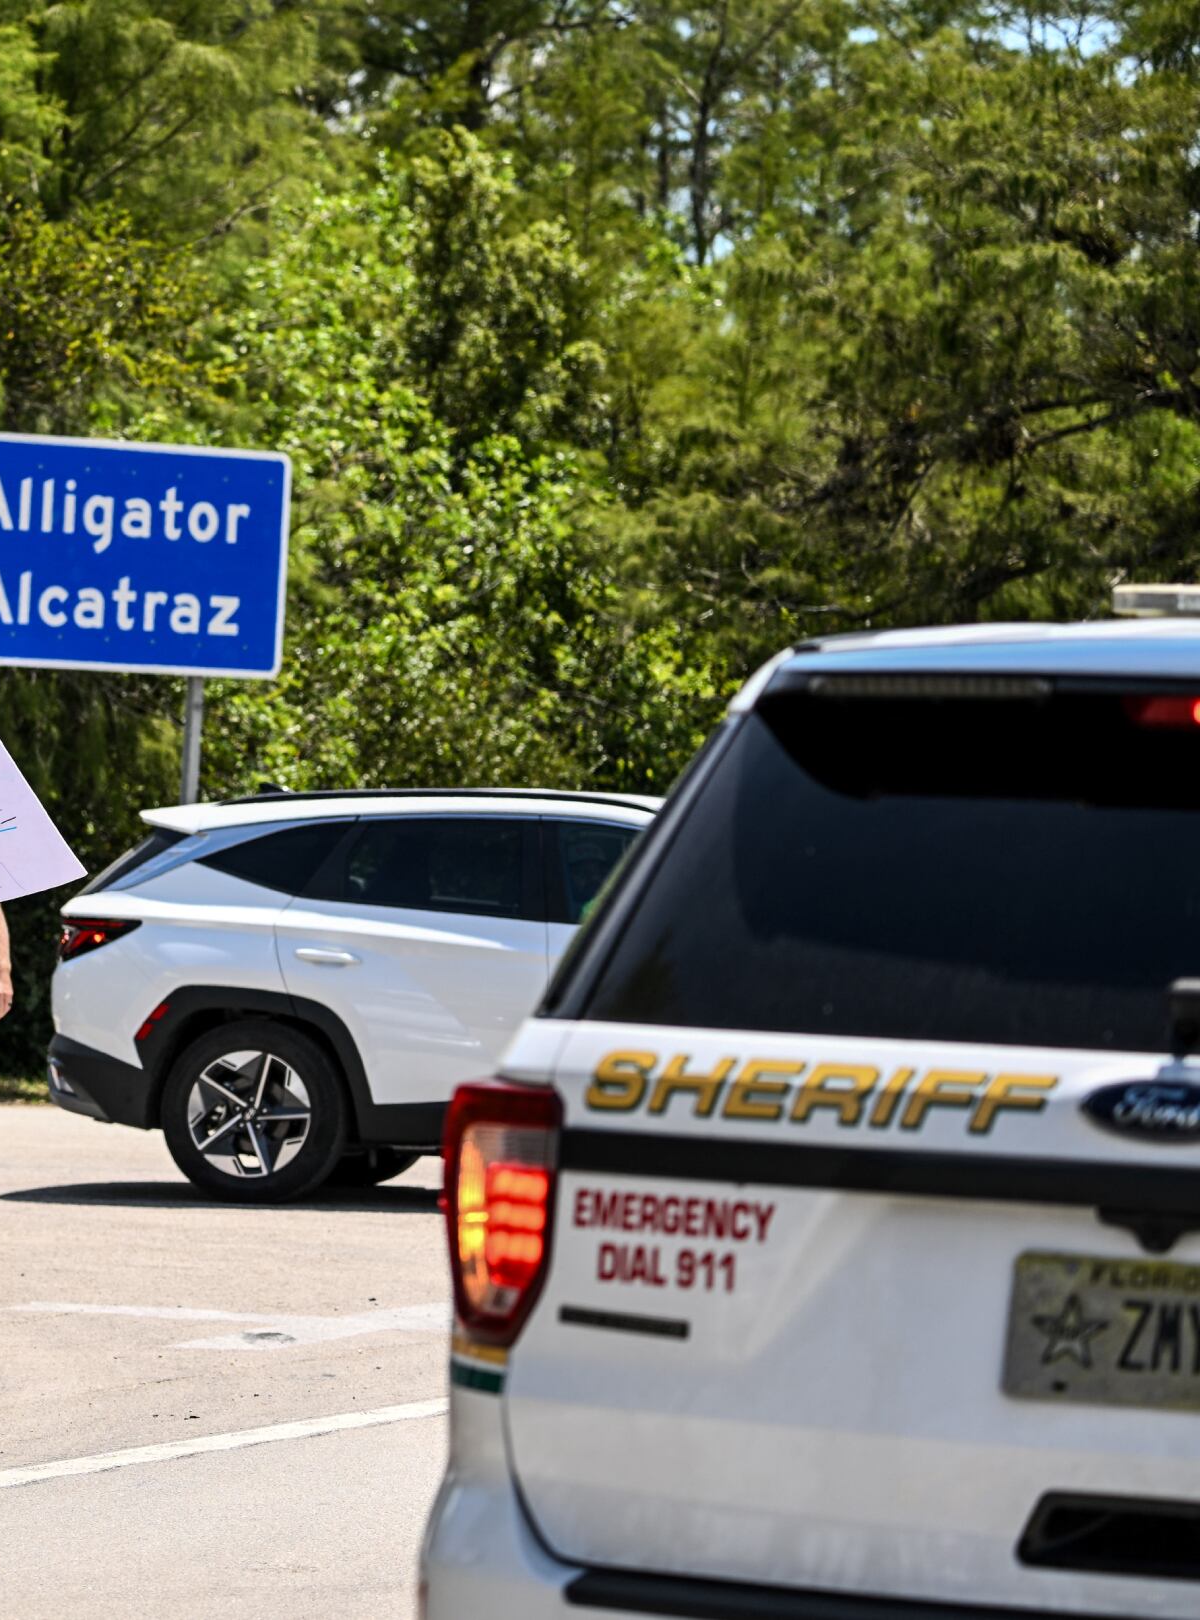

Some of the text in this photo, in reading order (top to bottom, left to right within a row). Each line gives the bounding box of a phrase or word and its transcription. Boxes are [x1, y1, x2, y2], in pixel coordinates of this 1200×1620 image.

[585, 1049, 1059, 1134] SHERIFF
[573, 1187, 776, 1242] EMERGENCY
[597, 1242, 736, 1293] DIAL 911
